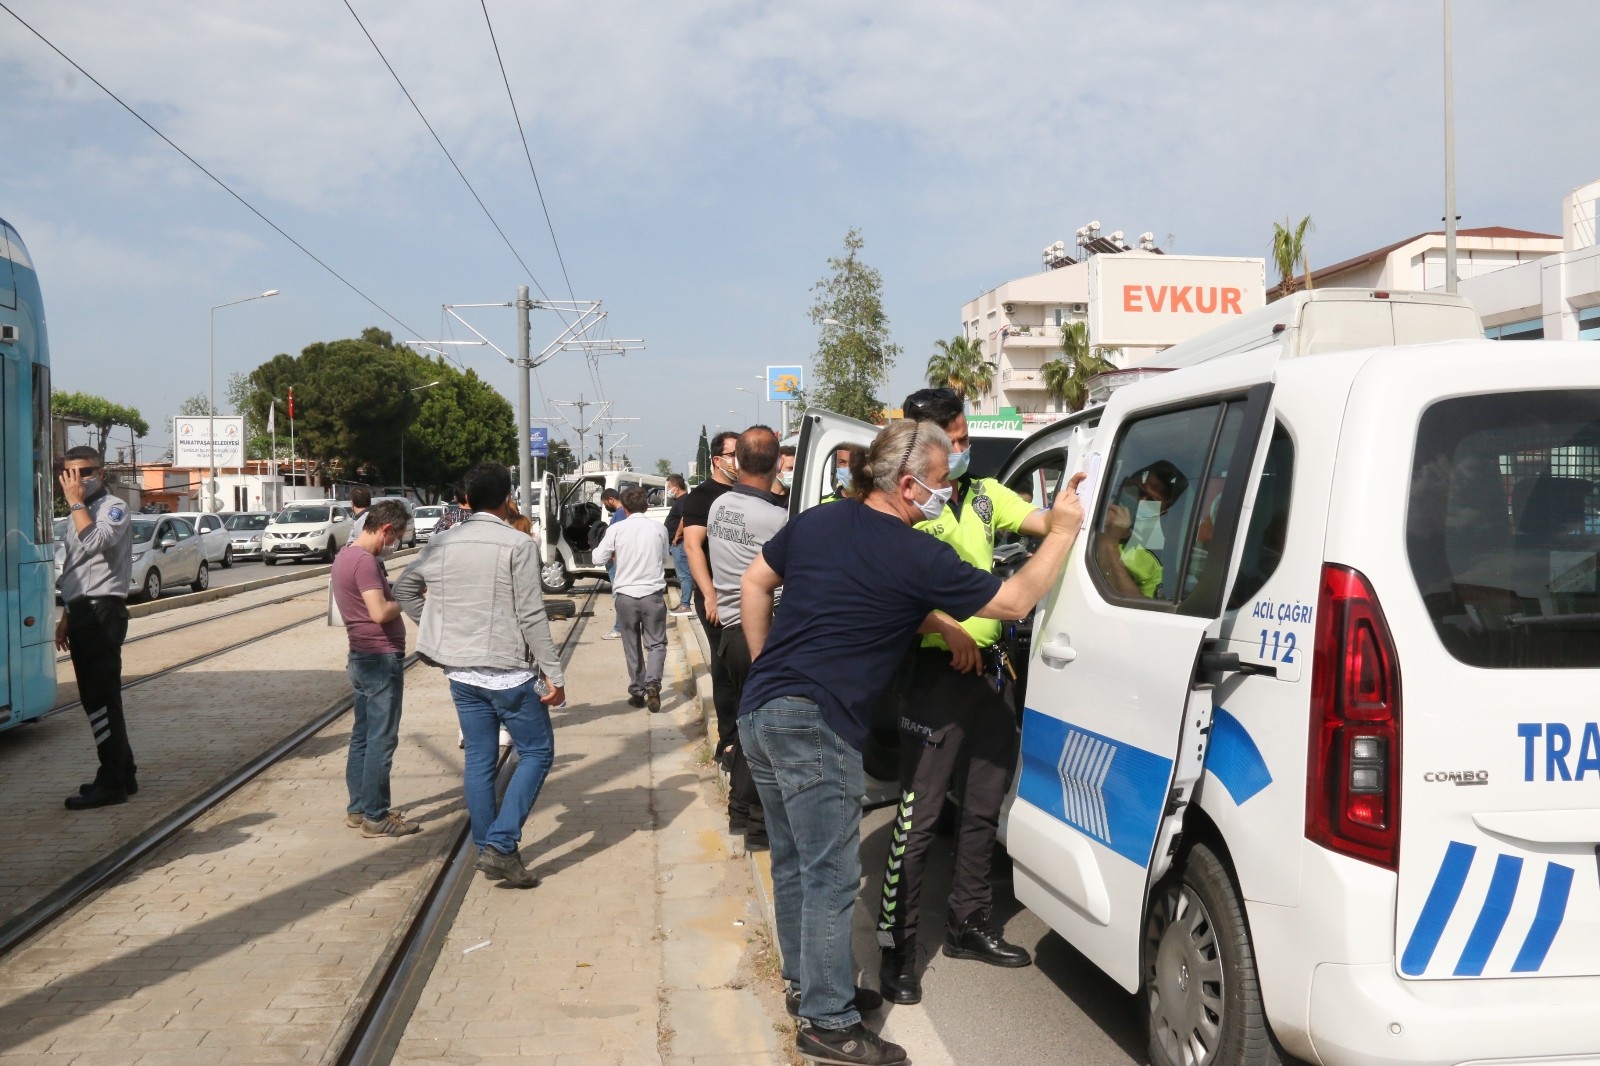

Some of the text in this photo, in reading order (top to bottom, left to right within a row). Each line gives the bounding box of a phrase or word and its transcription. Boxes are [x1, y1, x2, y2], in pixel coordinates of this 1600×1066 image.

[1123, 284, 1243, 316] EVKUR
[716, 505, 746, 527] ÖZEL
[1252, 597, 1314, 626] ACİL ÇAĞRI
[1258, 628, 1297, 664] 112
[1517, 722, 1600, 782] TRA
[1424, 770, 1489, 783] COMBO
